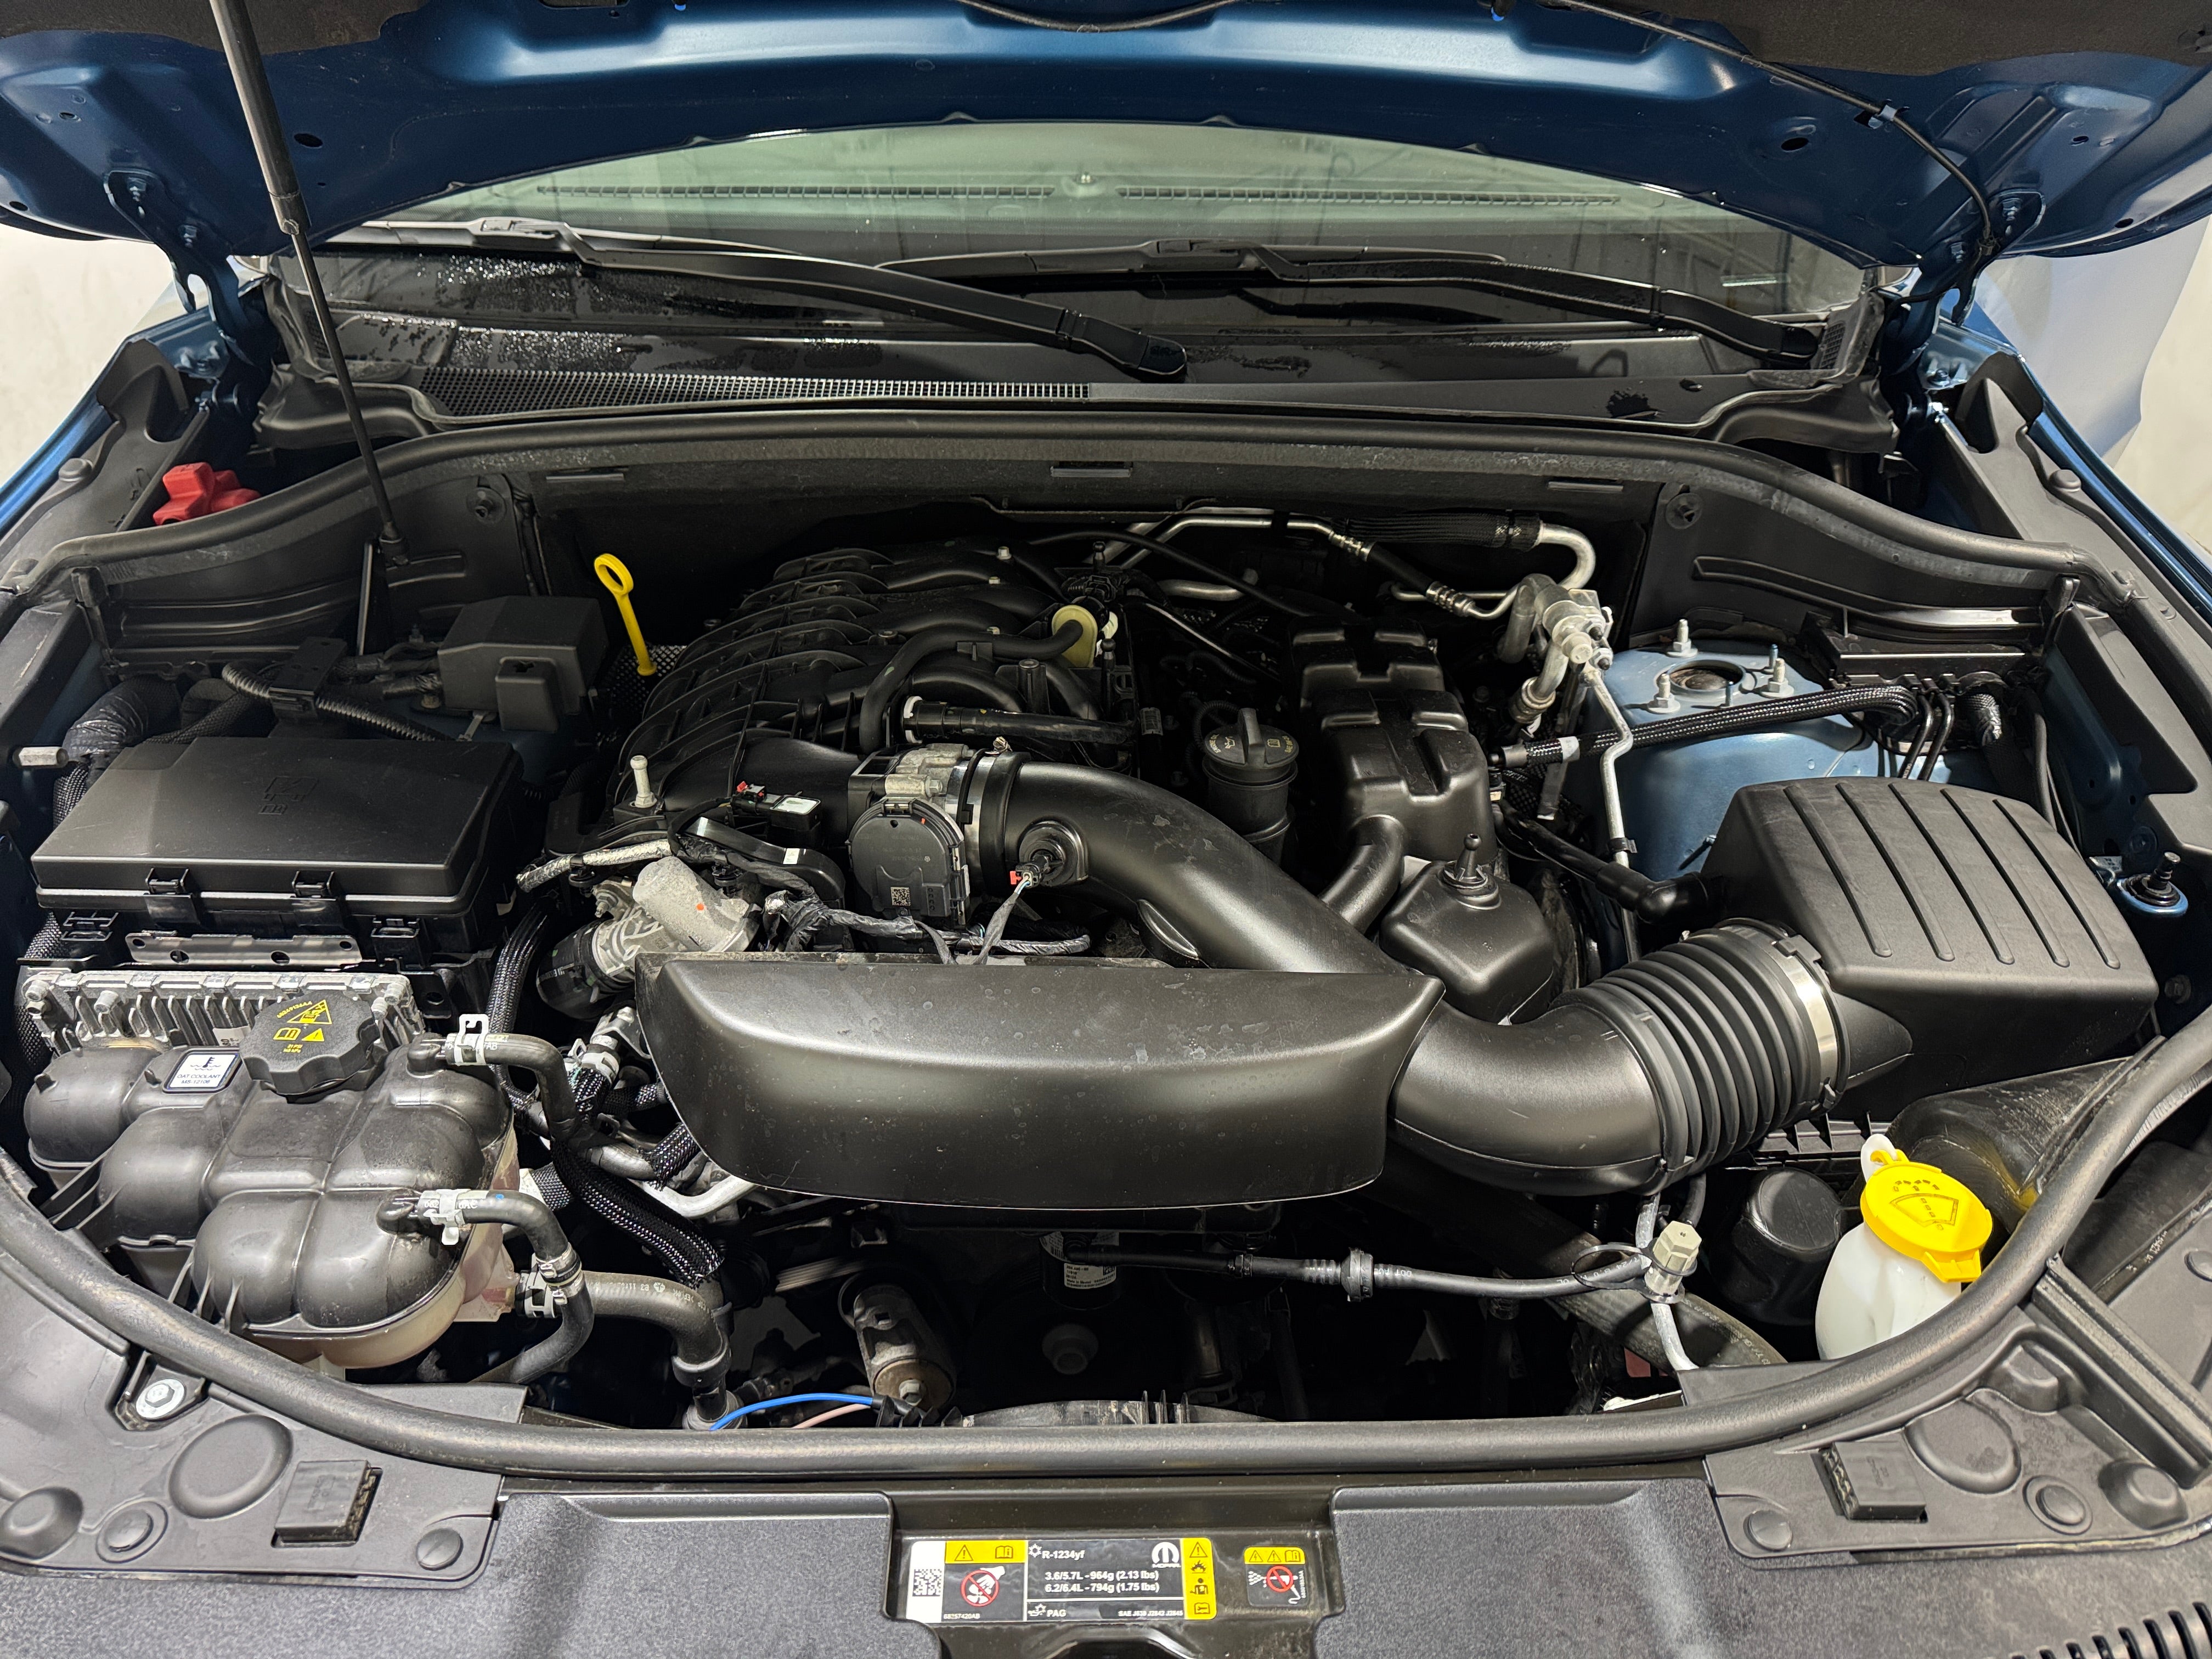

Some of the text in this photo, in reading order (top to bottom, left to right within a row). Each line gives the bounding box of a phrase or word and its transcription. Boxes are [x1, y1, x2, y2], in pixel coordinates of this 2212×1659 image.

[1042, 1550, 1086, 1561] R-1234yf
[1045, 1571, 1084, 1580] 3.6/5.7L
[1116, 1570, 1139, 1581] (2.13
[1140, 1570, 1159, 1581] lbs)
[1045, 1583, 1084, 1593] 6.2/6.4L
[1116, 1582, 1139, 1593] (1.75
[1141, 1582, 1160, 1593] lbs)
[1046, 1609, 1066, 1617] PAG
